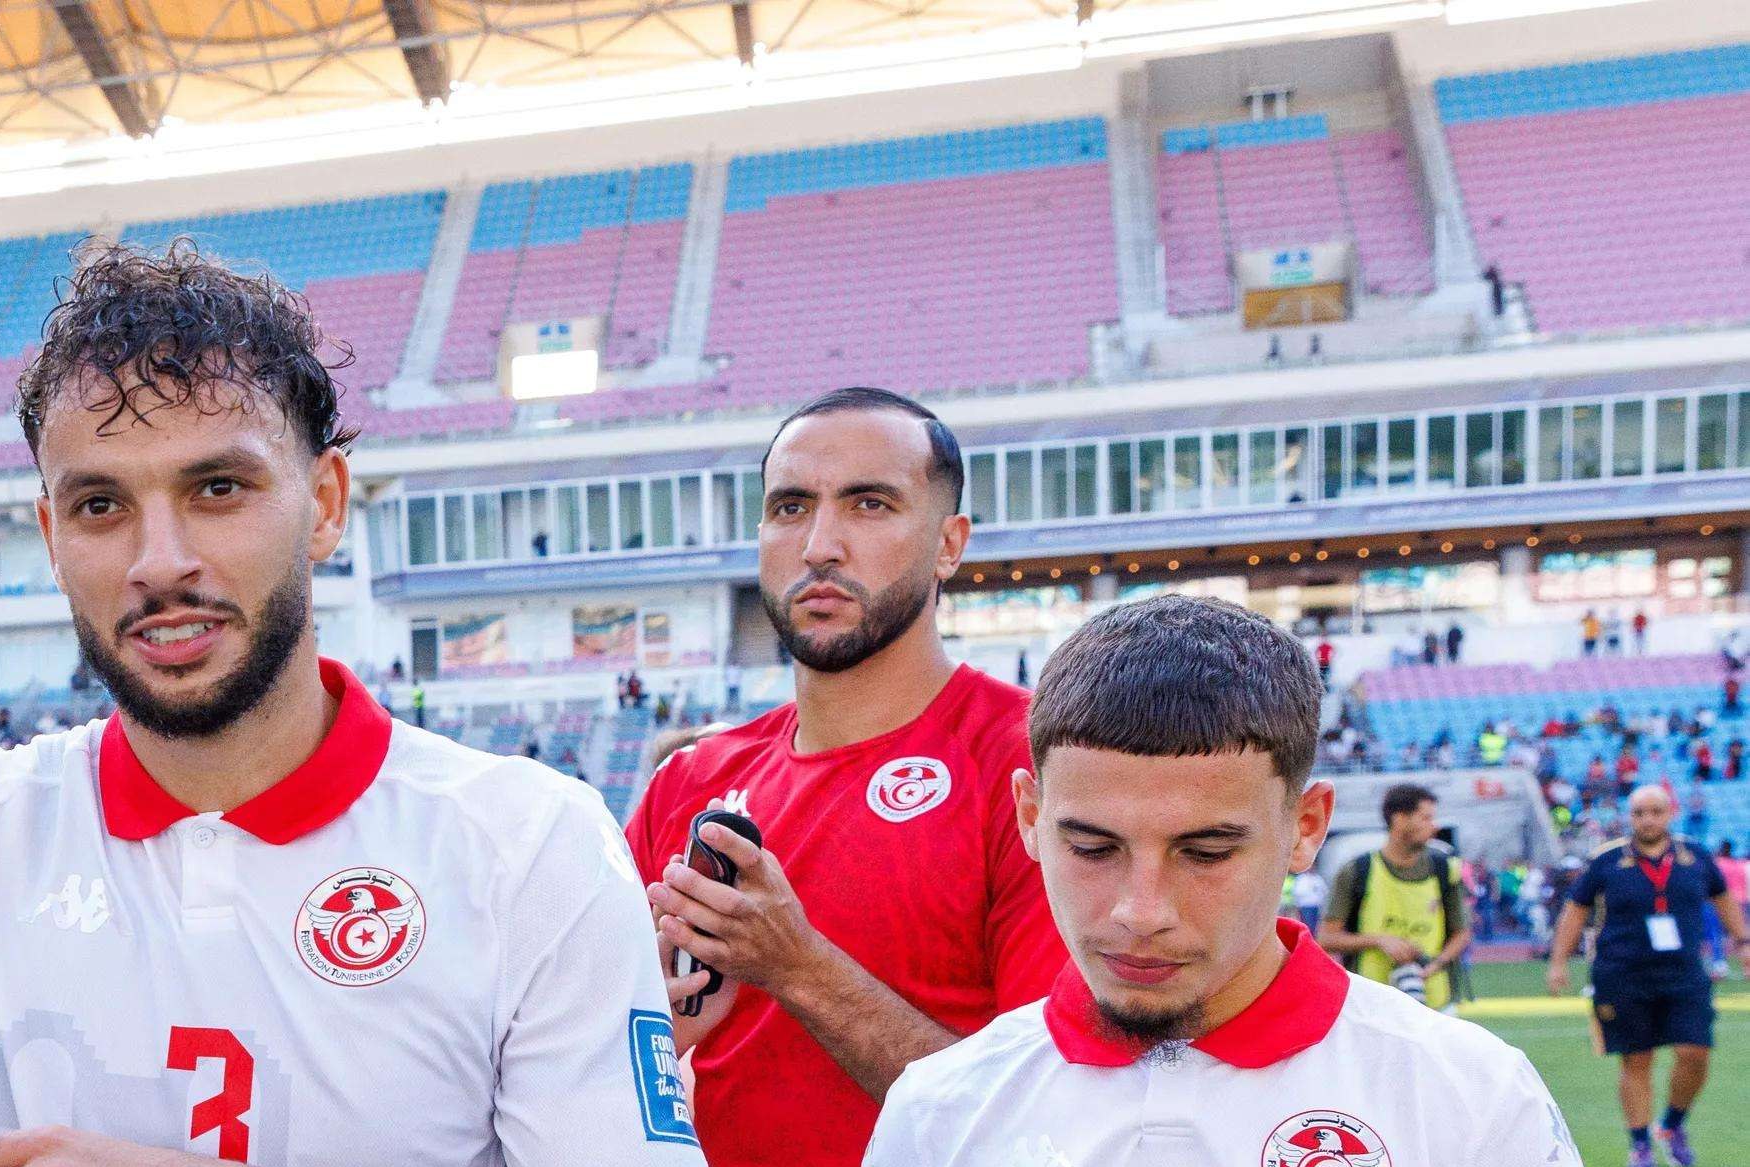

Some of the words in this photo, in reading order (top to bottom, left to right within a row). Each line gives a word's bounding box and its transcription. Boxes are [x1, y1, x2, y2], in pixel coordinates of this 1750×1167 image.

[330, 968, 384, 981] TUNISIENNE
[386, 963, 396, 973] DE
[396, 926, 420, 964] FOOTBALL
